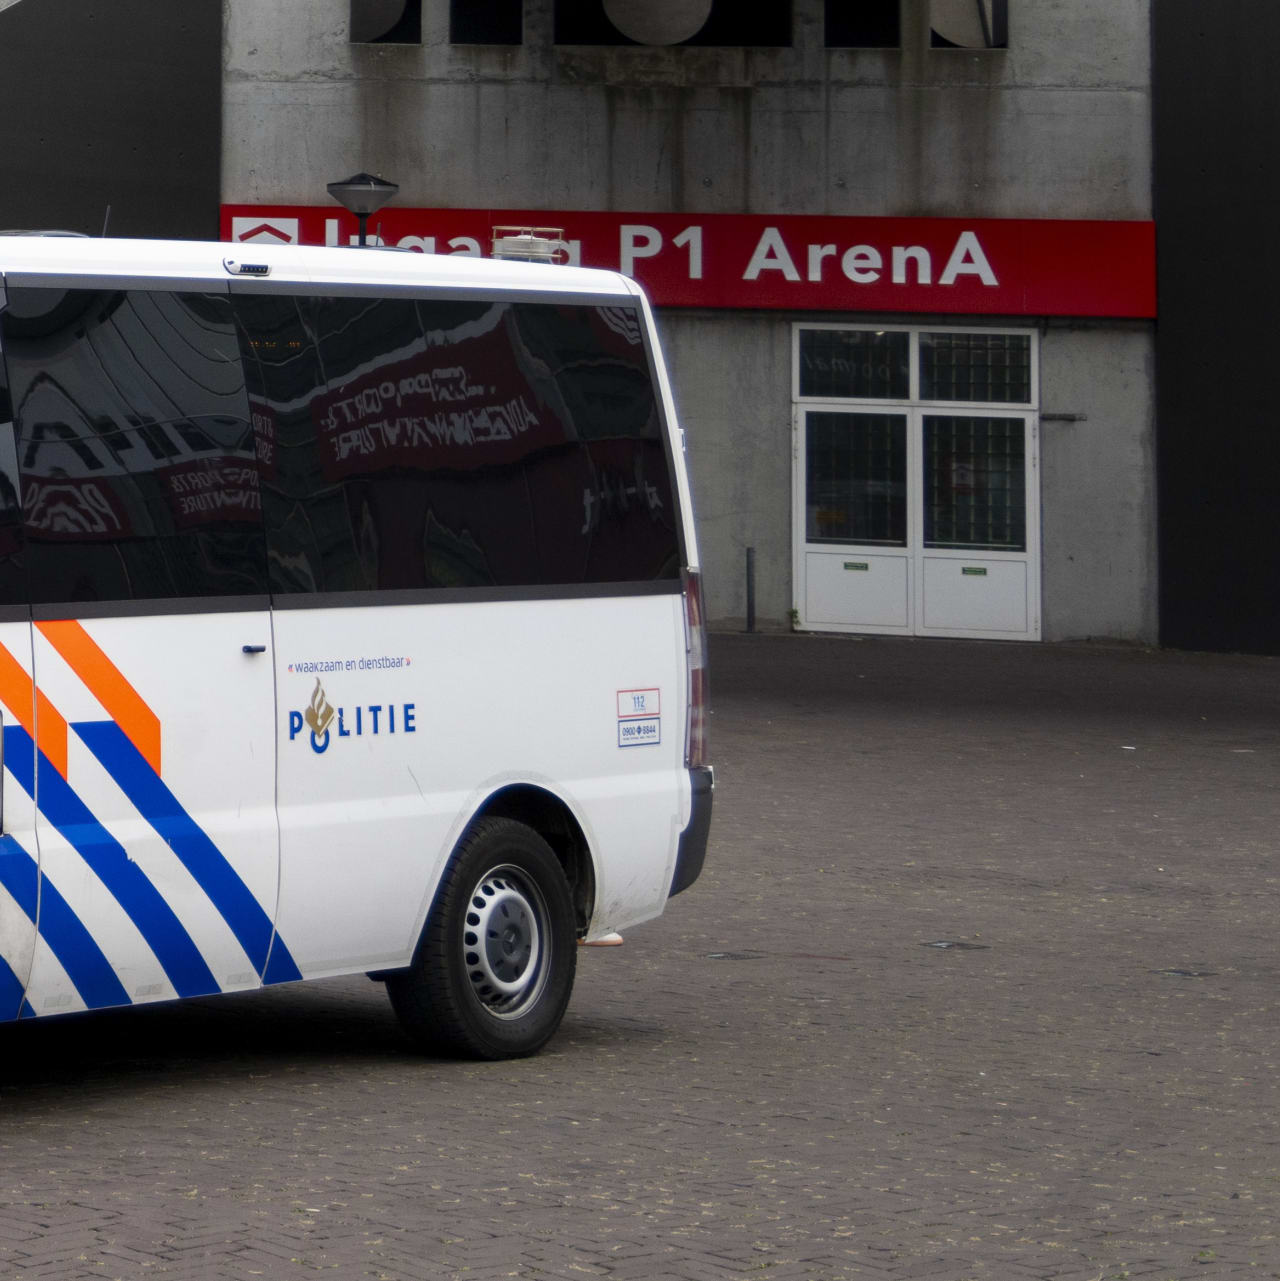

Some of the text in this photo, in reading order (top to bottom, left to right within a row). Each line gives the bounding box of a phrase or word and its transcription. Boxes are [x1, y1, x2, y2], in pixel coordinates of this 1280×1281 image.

[620, 224, 704, 281] P1
[742, 226, 1001, 288] ArenA
[345, 660, 357, 671] en
[288, 702, 416, 754] POLITIE
